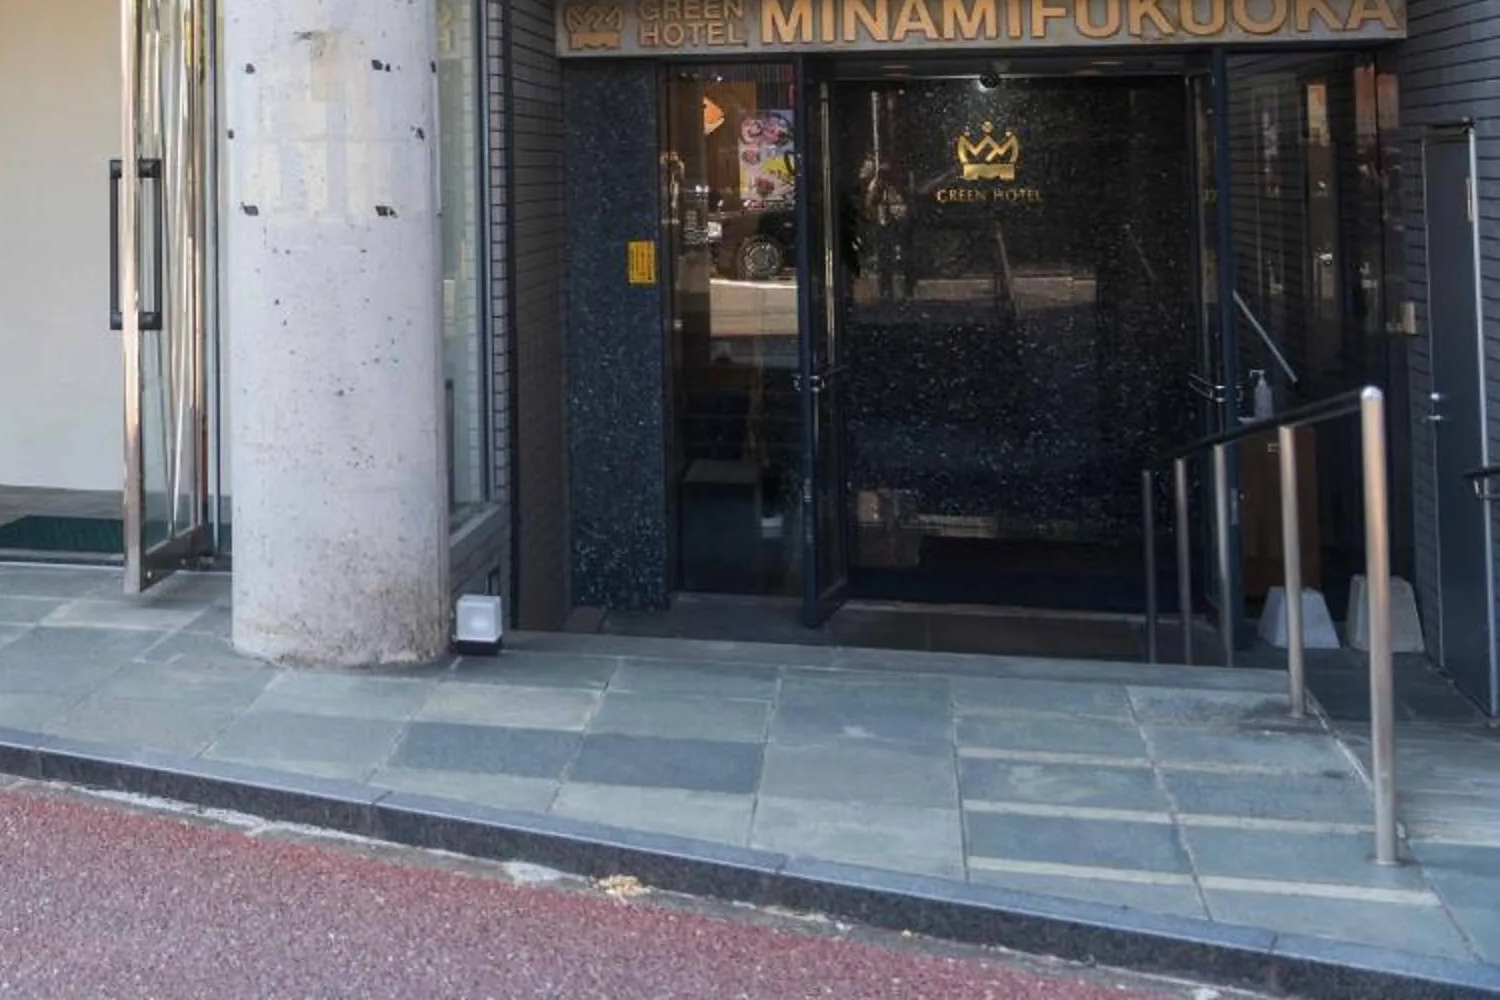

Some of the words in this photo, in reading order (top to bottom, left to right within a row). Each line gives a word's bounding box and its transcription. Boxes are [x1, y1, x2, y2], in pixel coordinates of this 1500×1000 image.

[639, 21, 748, 47] HOTEL
[936, 187, 987, 201] GREEN
[992, 187, 1041, 201] HOTEL
